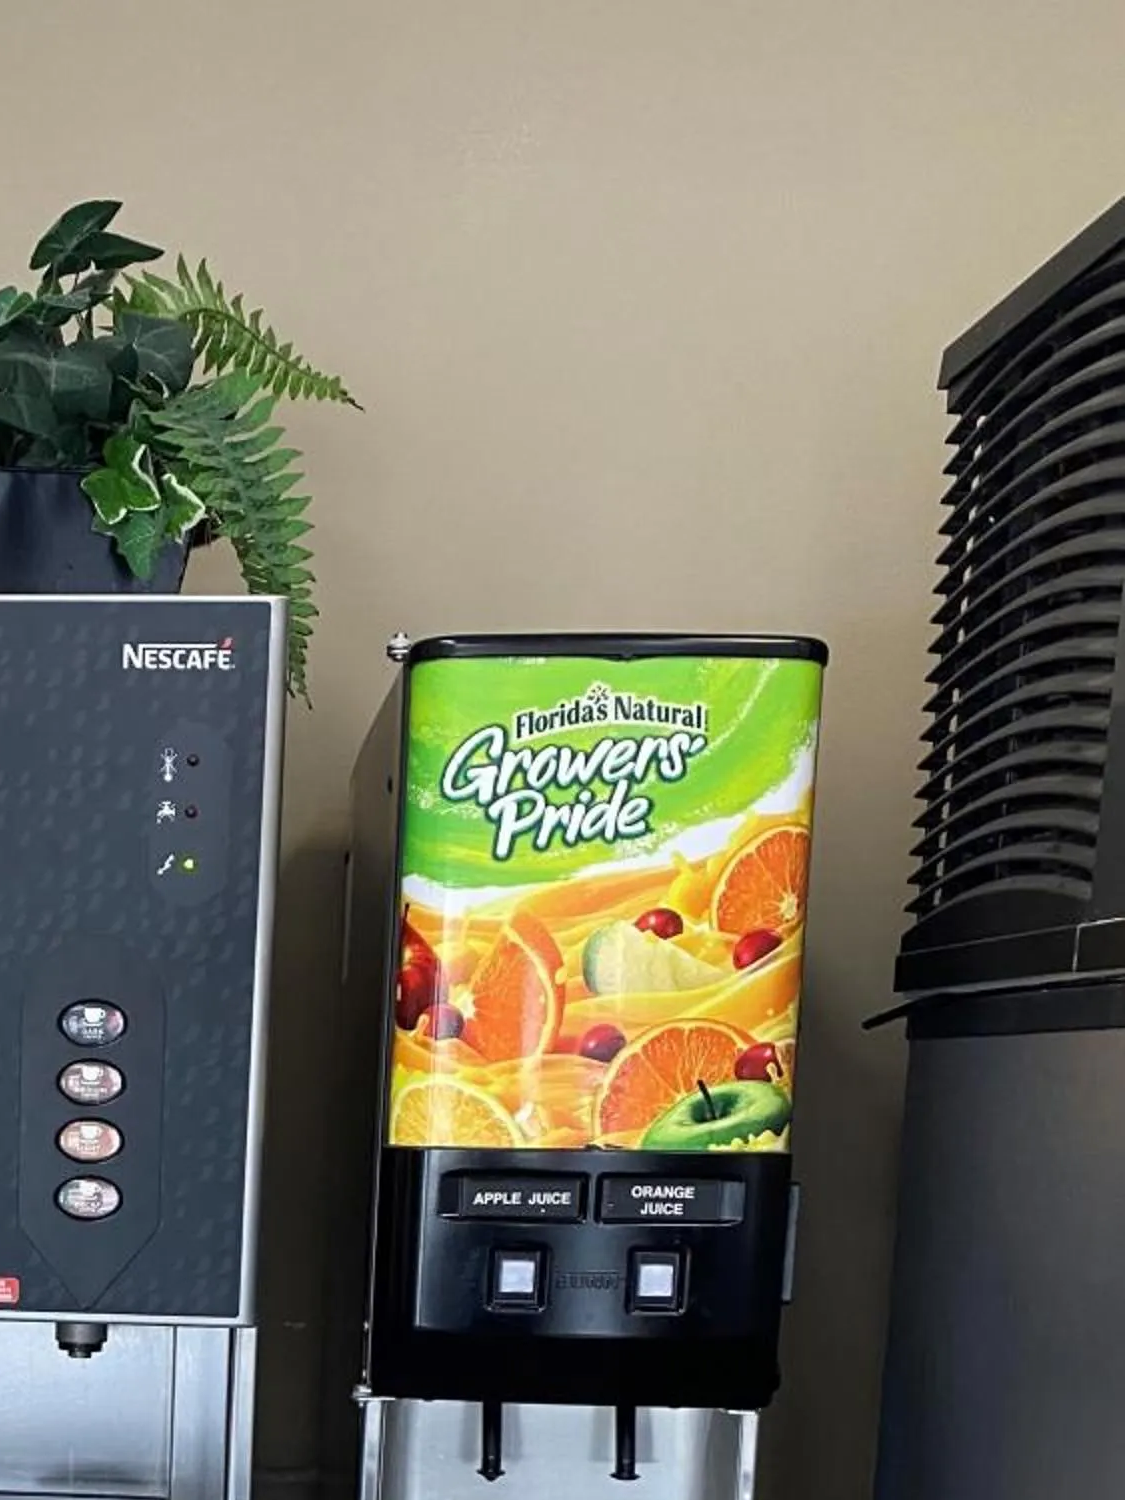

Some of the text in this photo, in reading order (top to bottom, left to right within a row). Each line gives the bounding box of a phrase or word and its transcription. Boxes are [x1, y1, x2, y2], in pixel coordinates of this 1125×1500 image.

[484, 777, 652, 861] Pride
[473, 1191, 572, 1205] APPLE JUICE
[631, 1185, 695, 1199] ORANGE
[640, 1202, 684, 1215] JUICE
